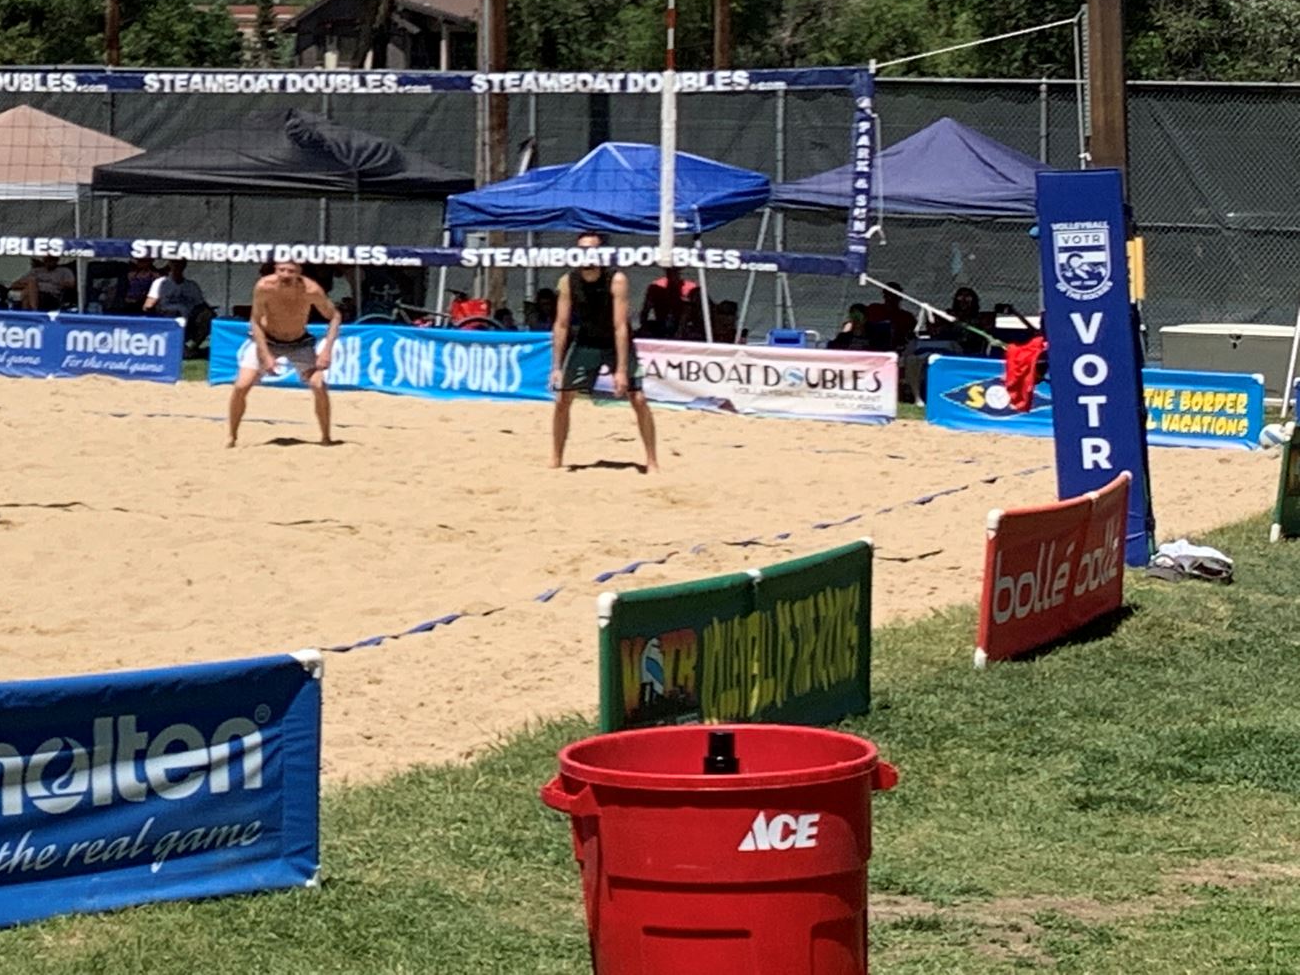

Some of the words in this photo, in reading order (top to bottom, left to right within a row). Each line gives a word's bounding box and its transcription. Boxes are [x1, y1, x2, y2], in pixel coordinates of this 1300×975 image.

[144, 73, 284, 93] STEAMBOAT
[471, 72, 624, 93] STEAMBOAT
[626, 70, 787, 91] DOBLES.com
[131, 239, 272, 263] STEAMBOAT
[1061, 235, 1101, 244] VOTR
[460, 247, 616, 268] STEAMBOAT
[66, 327, 166, 357] molten
[61, 355, 82, 369] For
[367, 337, 385, 386] &
[393, 336, 437, 388] SUN
[440, 342, 523, 393] SPORTS
[646, 359, 759, 384] AMBOAT
[762, 365, 882, 393] DOUBLES
[1070, 312, 1113, 470] VOTR
[1144, 389, 1176, 413] THE
[1179, 389, 1248, 415] BORDER
[1161, 413, 1249, 437] VACATIONS
[993, 540, 1076, 625] bollé
[738, 811, 821, 851] ACE
[69, 817, 155, 865] real
[155, 819, 262, 873] game
